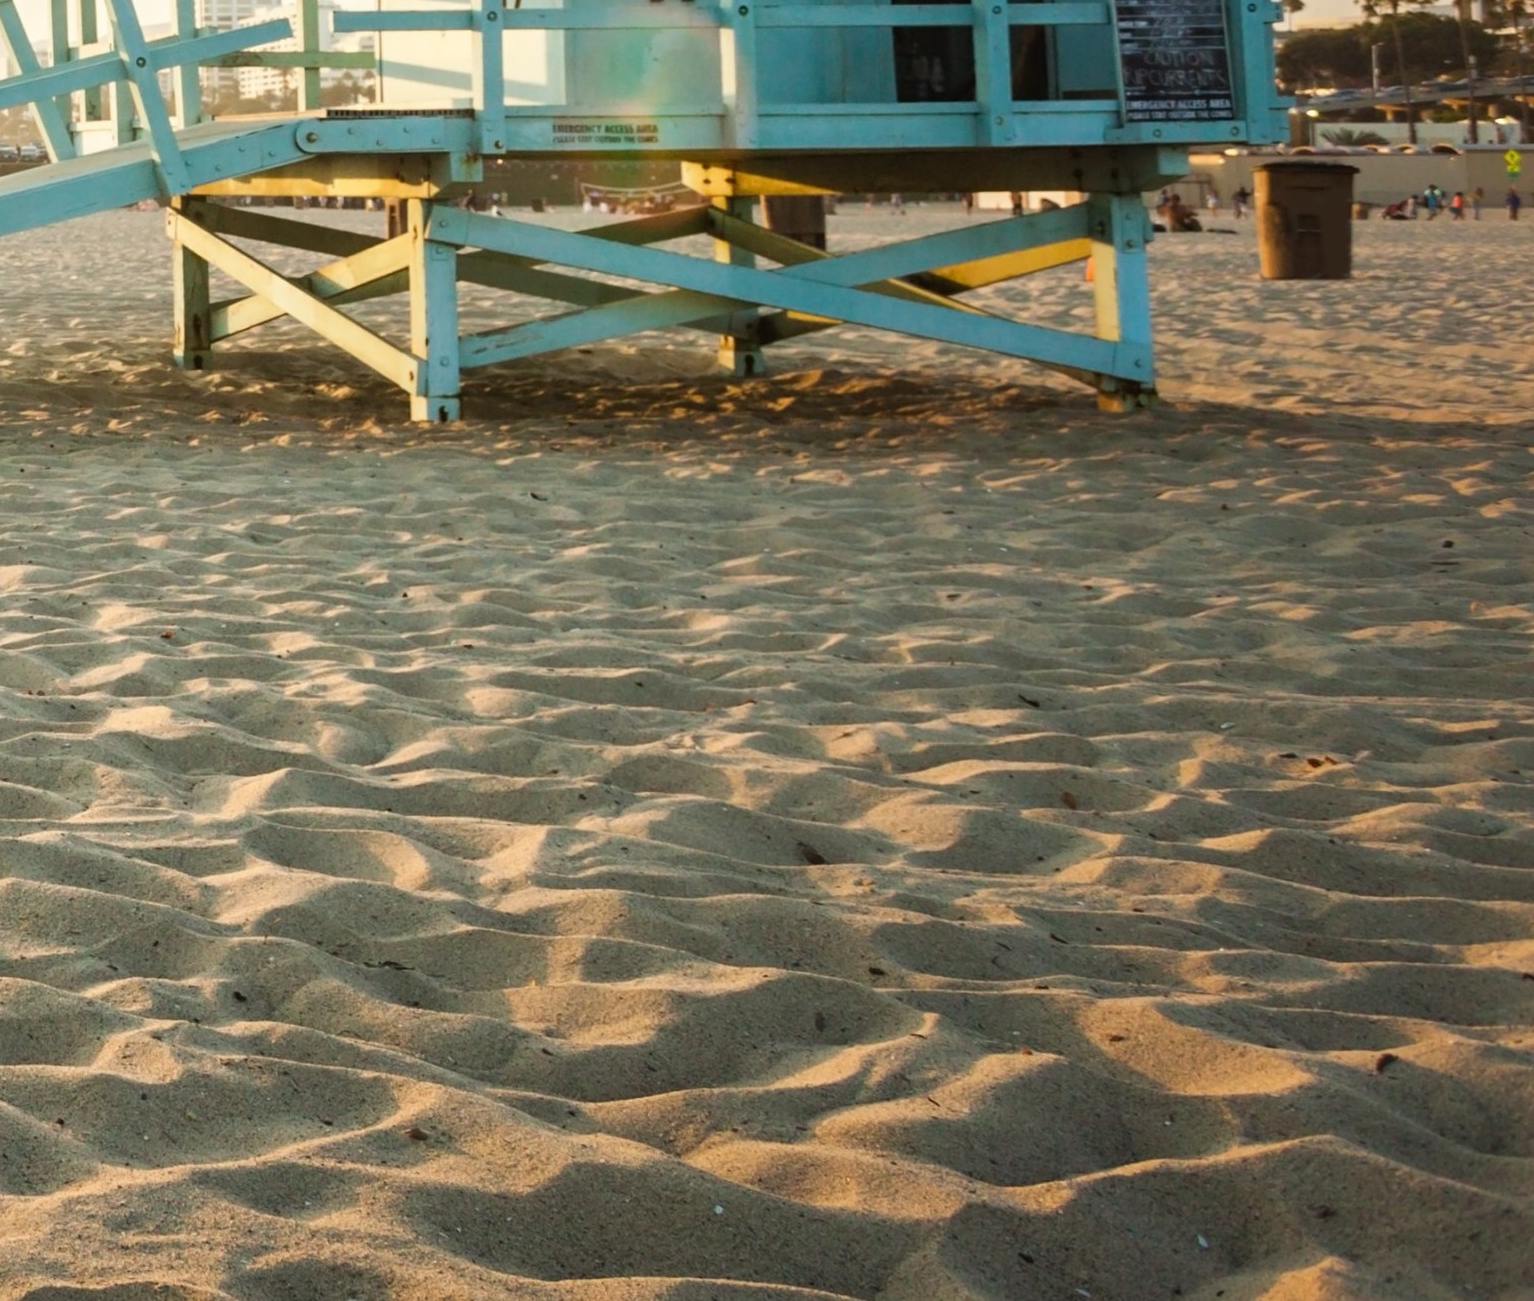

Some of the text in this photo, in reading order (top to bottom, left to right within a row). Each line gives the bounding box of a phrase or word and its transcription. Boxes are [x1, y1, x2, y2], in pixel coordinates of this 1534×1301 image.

[1144, 50, 1215, 67] CAUTION
[1126, 99, 1231, 109] EMERGENCY ACCESS AREA
[552, 124, 659, 133] EMERGENCY ACCESS AREA
